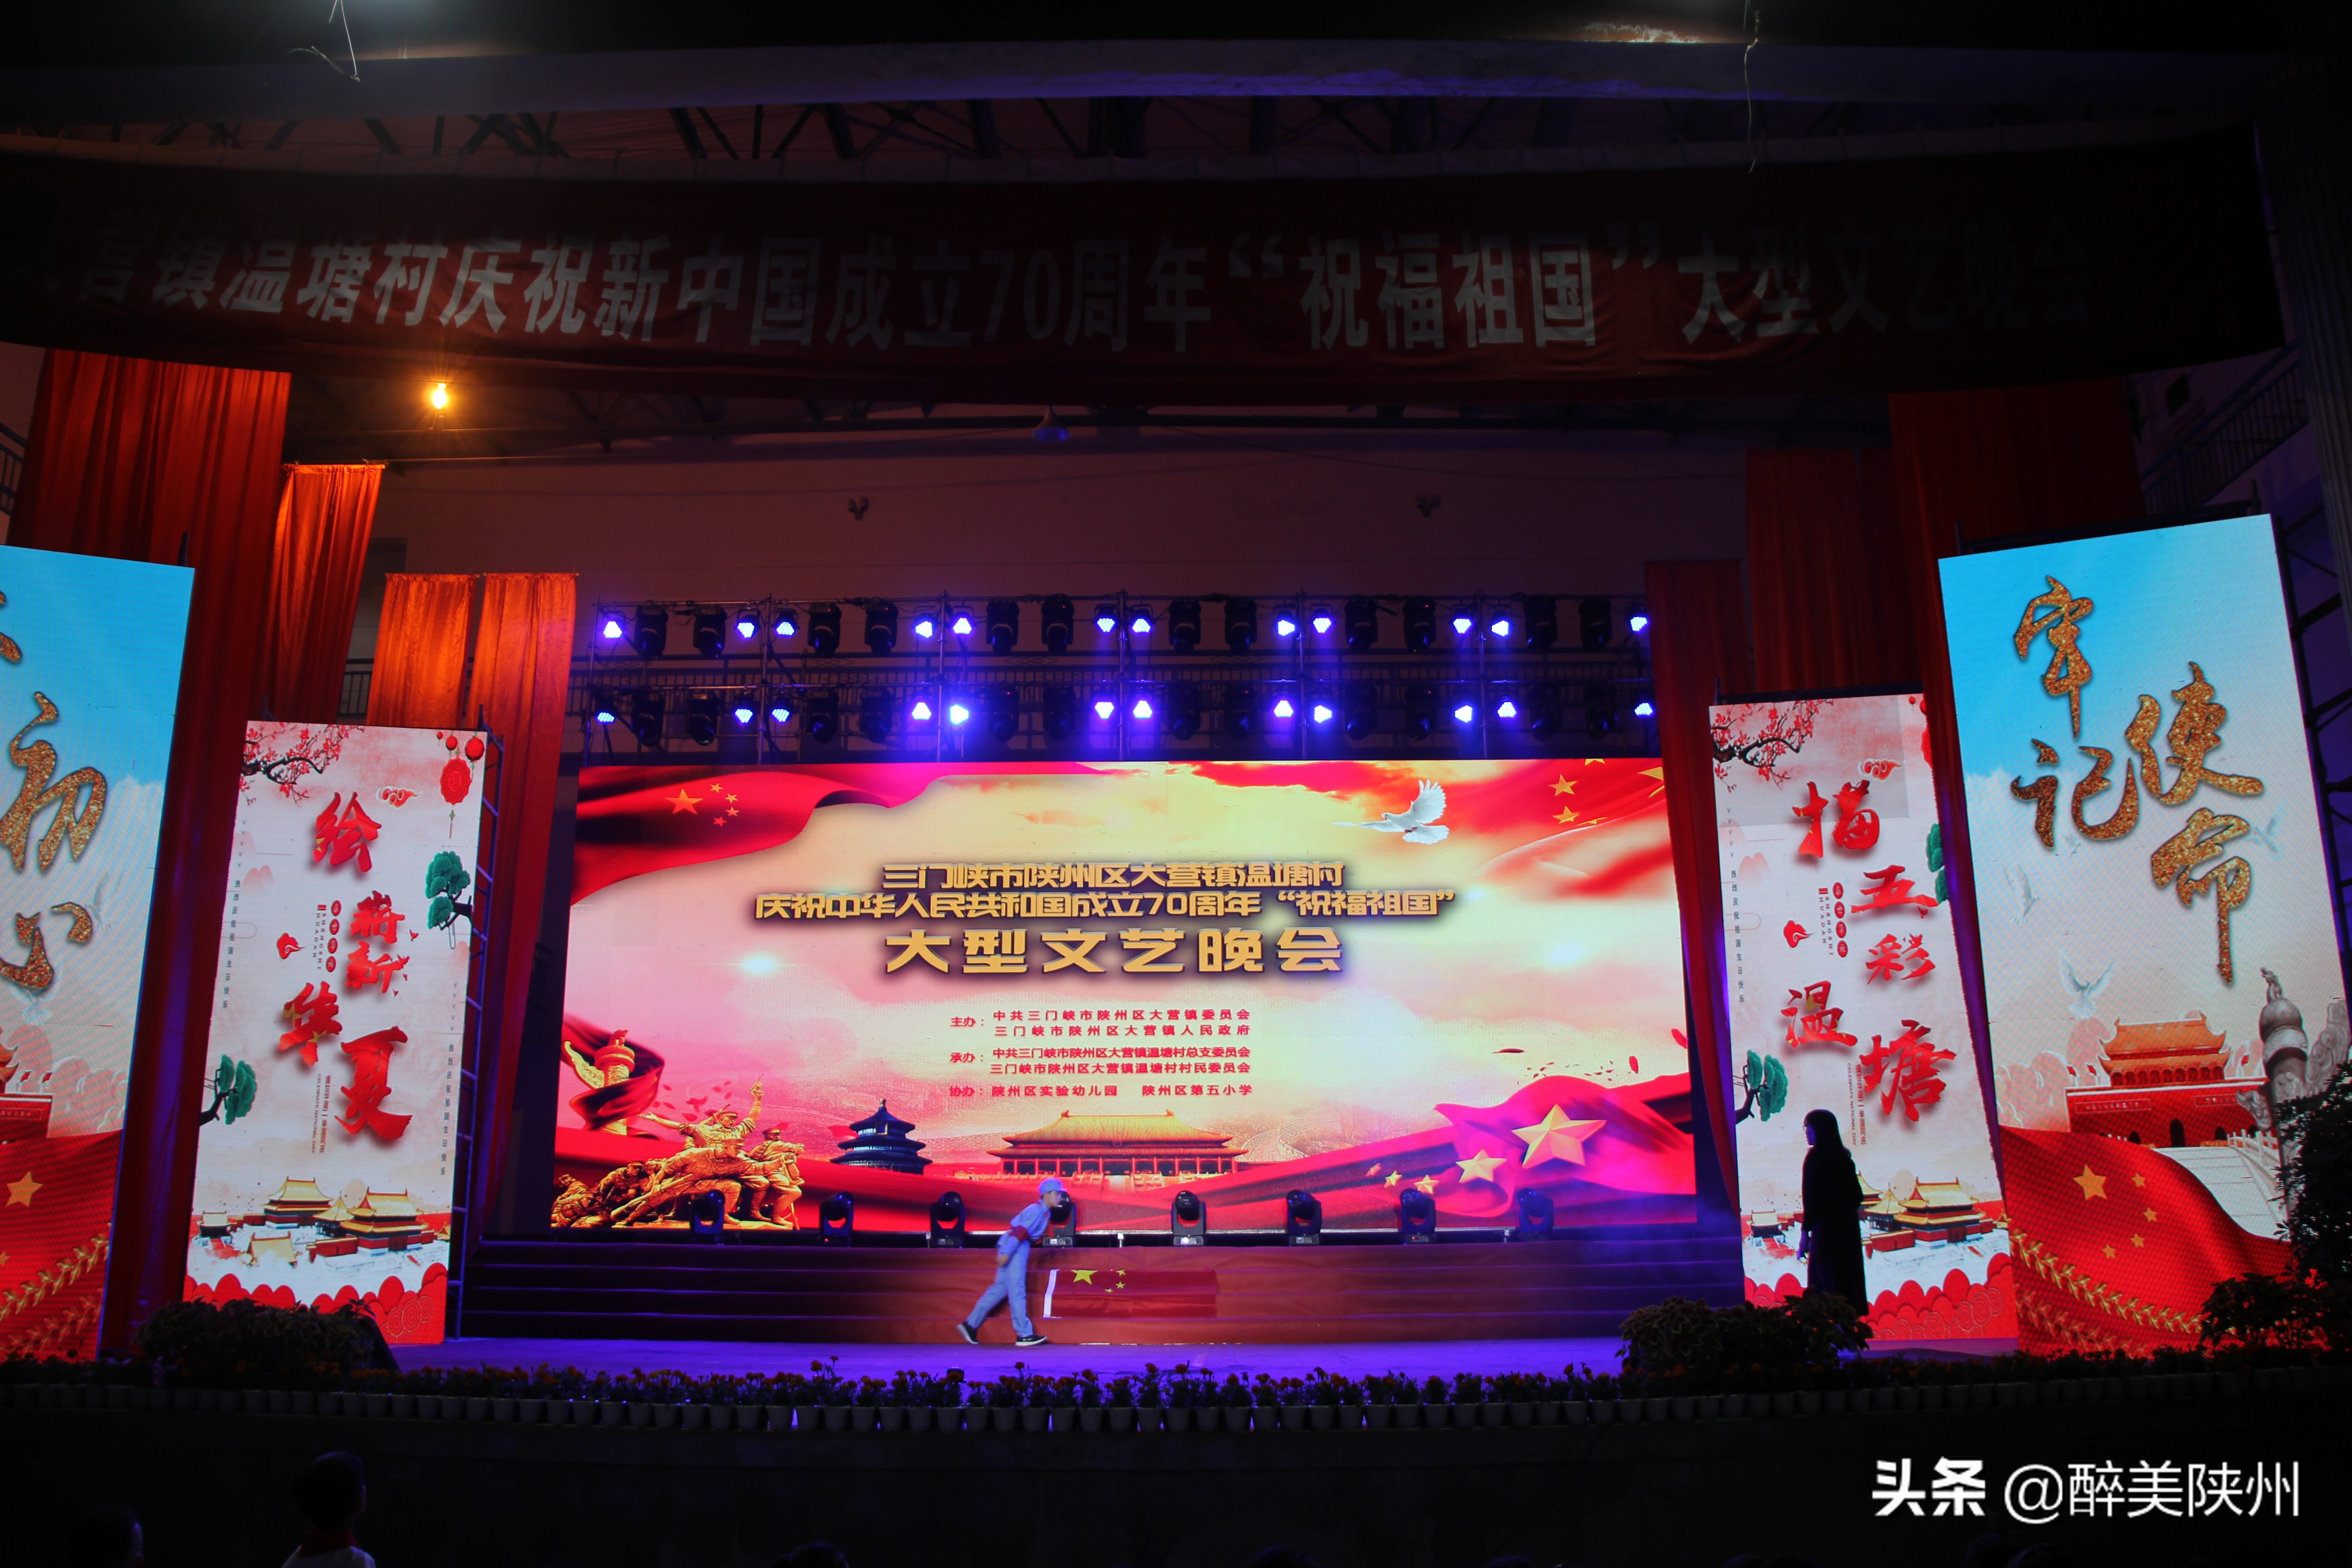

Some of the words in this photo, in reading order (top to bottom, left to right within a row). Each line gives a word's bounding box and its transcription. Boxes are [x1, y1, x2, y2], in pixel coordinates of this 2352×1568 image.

[882, 862, 1344, 889] 三门峡市陕州区大营镇温塘村
[885, 927, 1342, 974] 大型文艺晚会
[993, 1009, 1250, 1021] 中共三门峡市陕州区大营镇委员会
[994, 1025, 1250, 1037] 三门峡市陕州区大营镇人民政府
[992, 1046, 1250, 1058] 中共三门峡市陕州区大营镇温塘村总支委员会
[990, 1062, 1250, 1074] 三门峡市陕州区大营镇温塘村村民委员会
[992, 1085, 1117, 1097] 陕州区实验幼儿园
[1142, 1084, 1252, 1096] 陕州区第五小学
